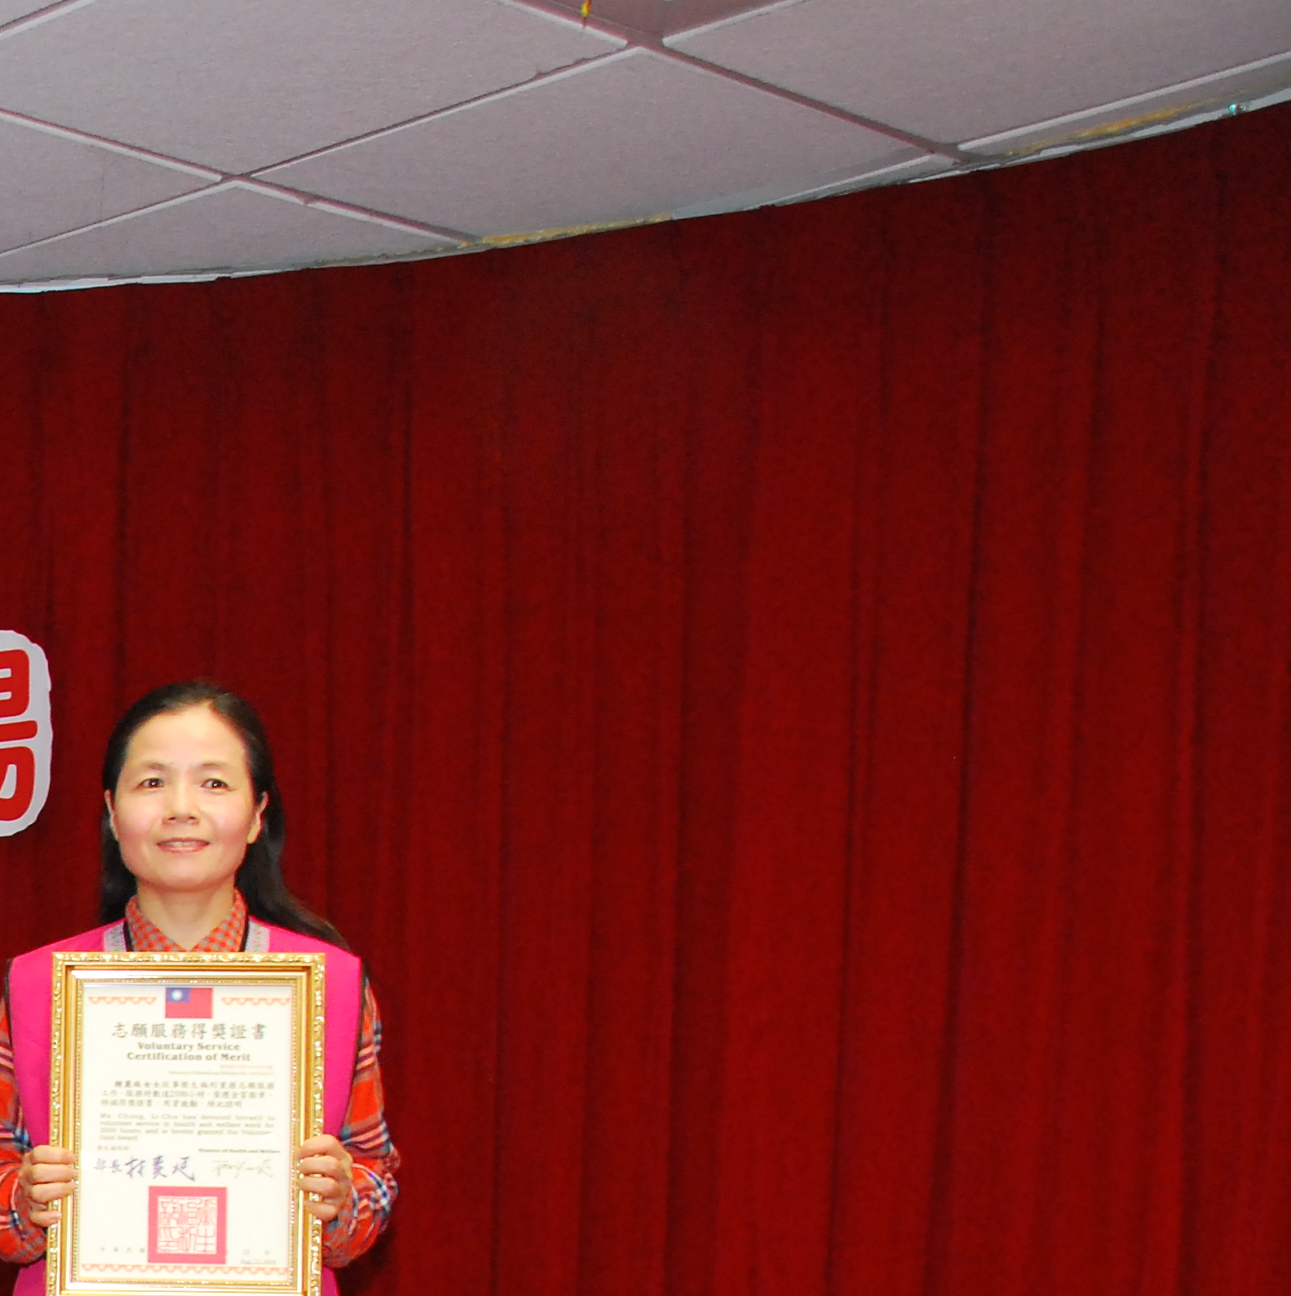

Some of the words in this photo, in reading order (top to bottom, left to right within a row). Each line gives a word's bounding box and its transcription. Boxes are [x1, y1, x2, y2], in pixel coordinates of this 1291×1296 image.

[111, 1022, 267, 1040] 志願服務得獎證書
[138, 1042, 194, 1052] Voluntary
[198, 1042, 240, 1051] Service
[127, 1052, 202, 1061] Certification
[205, 1052, 217, 1061] of
[220, 1052, 251, 1062] Merit
